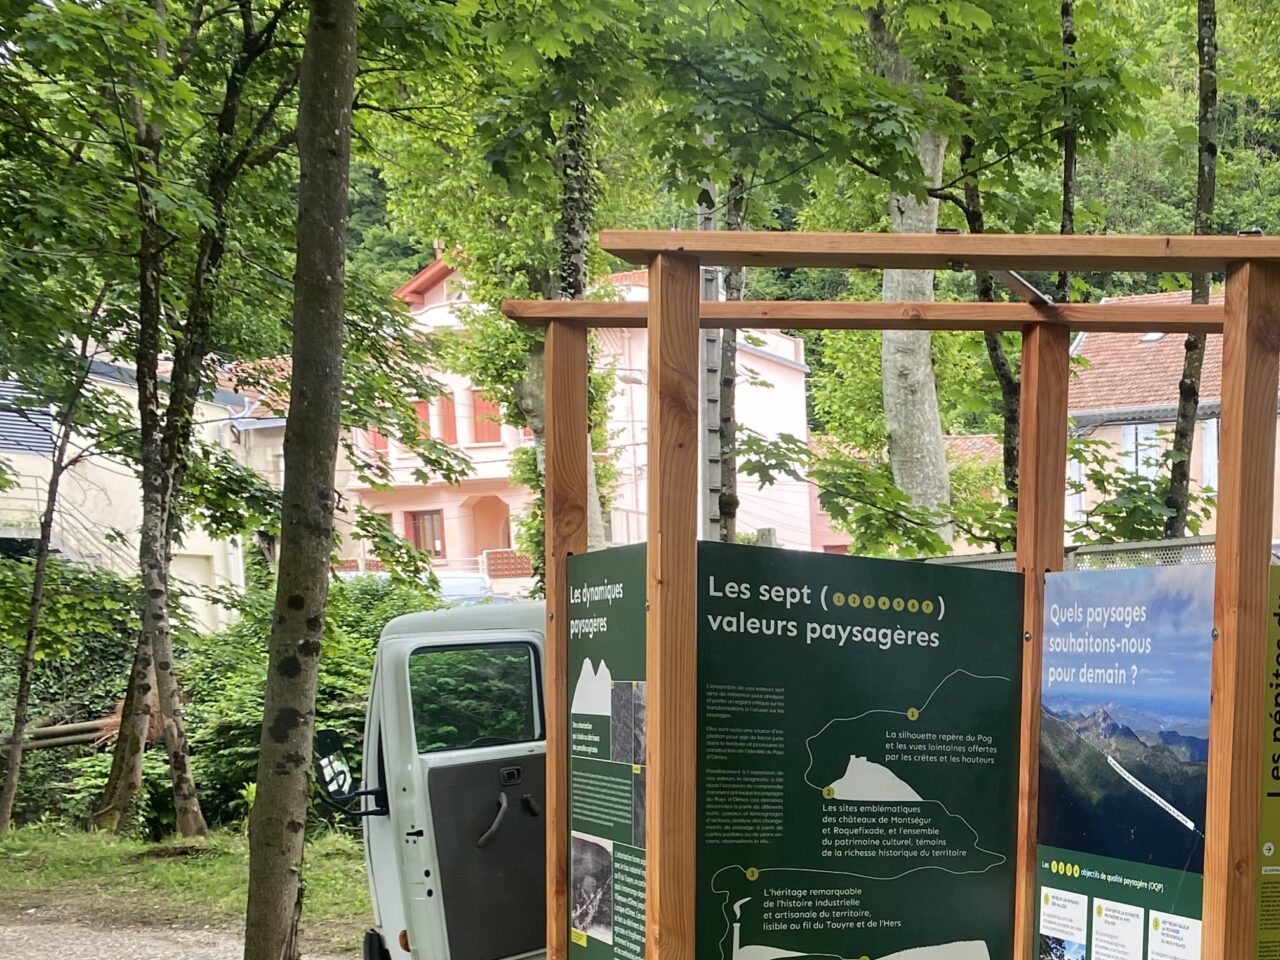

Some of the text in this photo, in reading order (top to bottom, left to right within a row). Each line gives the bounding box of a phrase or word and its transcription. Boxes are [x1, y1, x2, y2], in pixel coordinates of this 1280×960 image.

[570, 579, 623, 607] Les dynamiques
[709, 576, 811, 608] Les sept
[1050, 603, 1146, 628] Quels paysages
[570, 614, 607, 639] paysagères
[708, 612, 940, 650] valeurs paysagères
[1049, 632, 1151, 654] souhaitons-nous
[1049, 666, 1075, 686] pour
[1079, 662, 1126, 684] demain
[885, 730, 992, 744] La silhouette repère du Pog
[896, 741, 907, 750] les
[927, 742, 966, 752] lointaines
[967, 744, 997, 753] offertes
[885, 754, 899, 762] par
[901, 752, 912, 761] les
[913, 753, 937, 762] crêtes
[949, 754, 960, 762] les
[961, 755, 994, 764] hauteurs
[838, 803, 858, 812] sites
[859, 804, 921, 814] emblématiques
[821, 815, 931, 826] des châteaux de Montségur
[898, 826, 939, 835] l'ensemble
[821, 837, 832, 845] du
[834, 837, 880, 847] patrimoine
[915, 837, 946, 846] témoins
[821, 848, 967, 858] de la richesse historique du territoire
[763, 887, 862, 898] L'héritage remarquable
[763, 898, 860, 908] de l'histoire industrielle
[762, 911, 772, 919] et
[774, 910, 817, 919] artisanale
[819, 909, 830, 918] du
[762, 922, 788, 930] lisible
[802, 921, 811, 929] fil
[812, 921, 824, 929] du
[825, 920, 854, 930] Touyre
[856, 920, 865, 928] et
[866, 919, 877, 927] de
[879, 919, 901, 927] l'Hers
